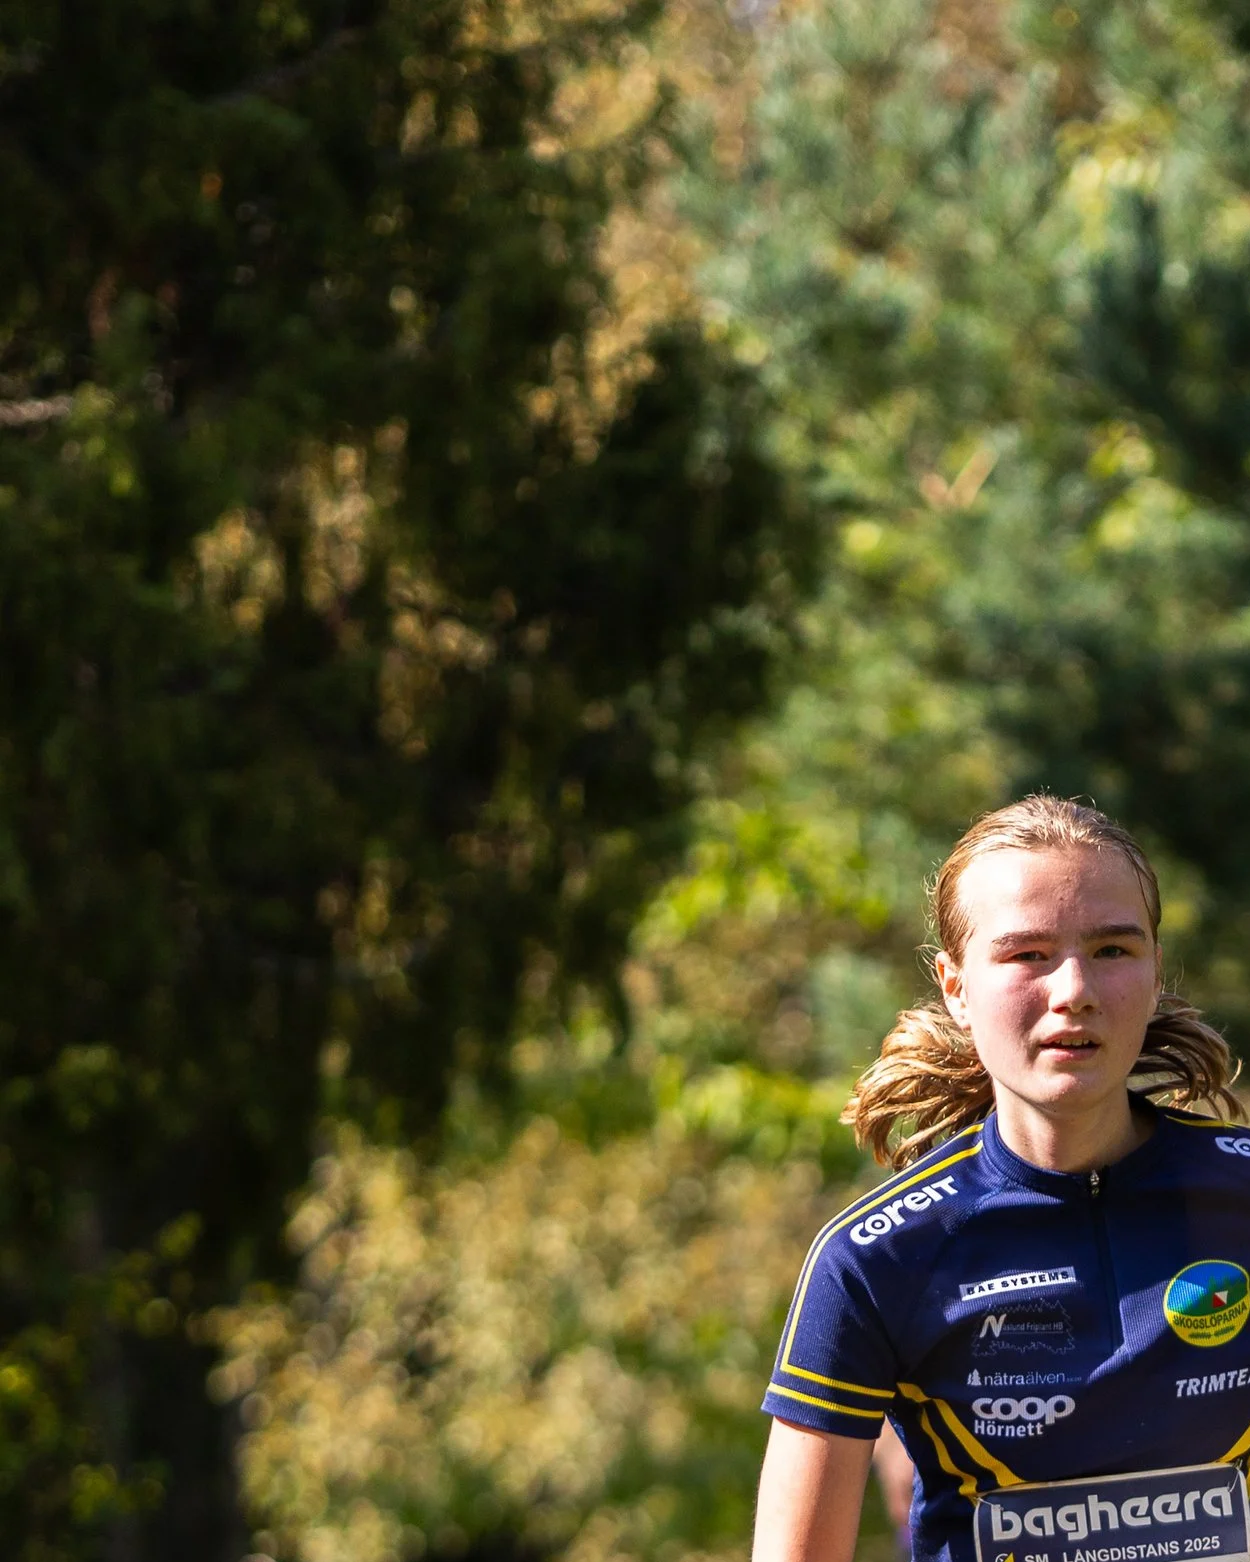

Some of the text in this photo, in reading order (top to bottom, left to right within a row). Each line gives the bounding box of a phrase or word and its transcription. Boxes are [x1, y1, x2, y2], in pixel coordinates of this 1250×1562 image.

[966, 1270, 1070, 1296] BAE SYSTEMS
[1173, 1301, 1248, 1330] SKOGSLÖPARNA
[984, 1371, 1066, 1386] nätraälven
[972, 1394, 1076, 1425] coop
[973, 1419, 1044, 1437] Hörnett
[991, 1485, 1233, 1542] bagheera
[1184, 1535, 1221, 1552] 2025
